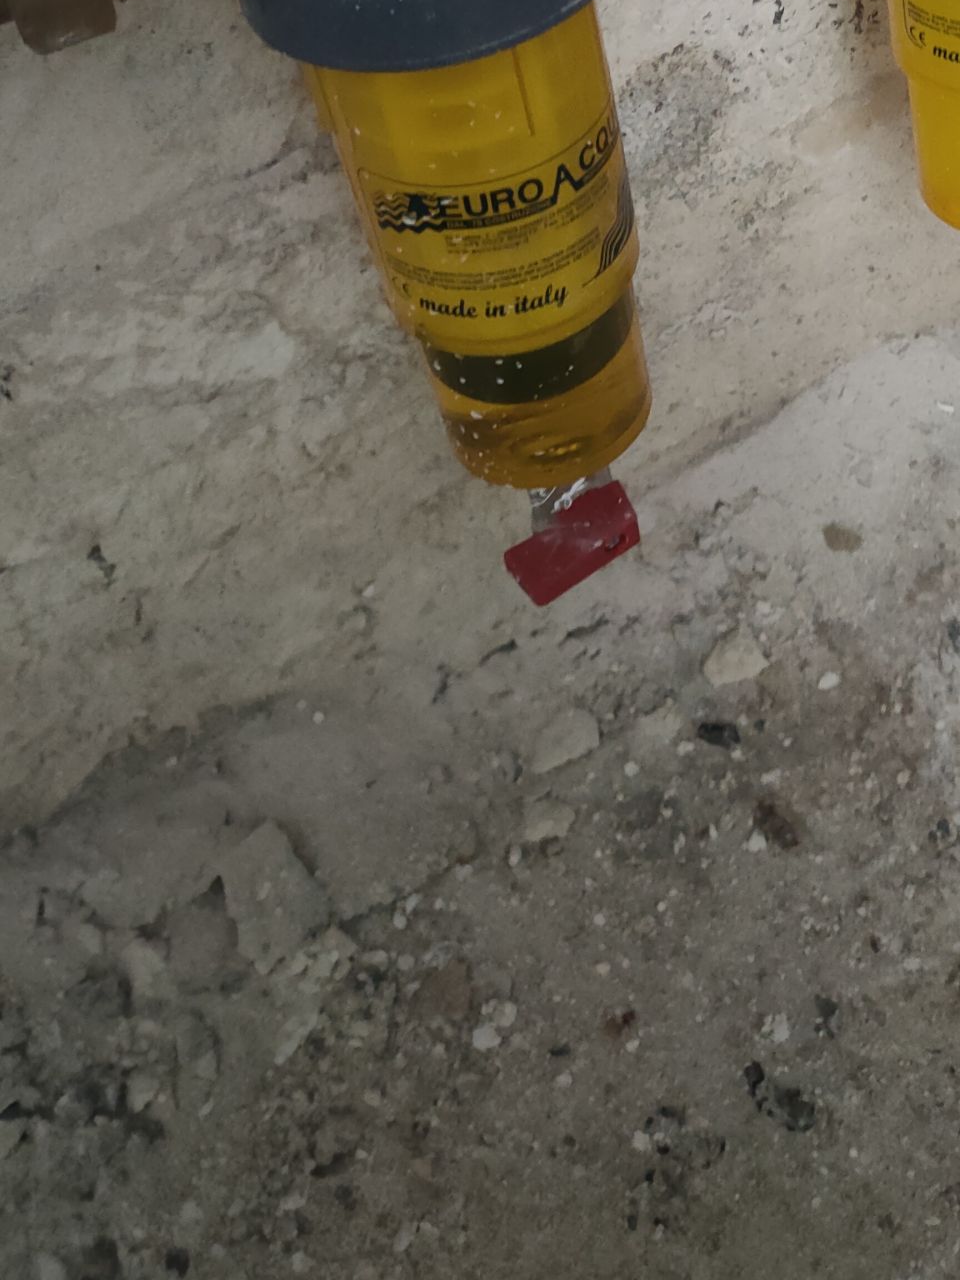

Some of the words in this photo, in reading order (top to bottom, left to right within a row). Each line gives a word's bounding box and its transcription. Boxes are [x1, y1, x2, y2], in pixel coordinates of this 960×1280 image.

[419, 296, 478, 319] made
[485, 299, 507, 318] in
[514, 284, 569, 315] italy
